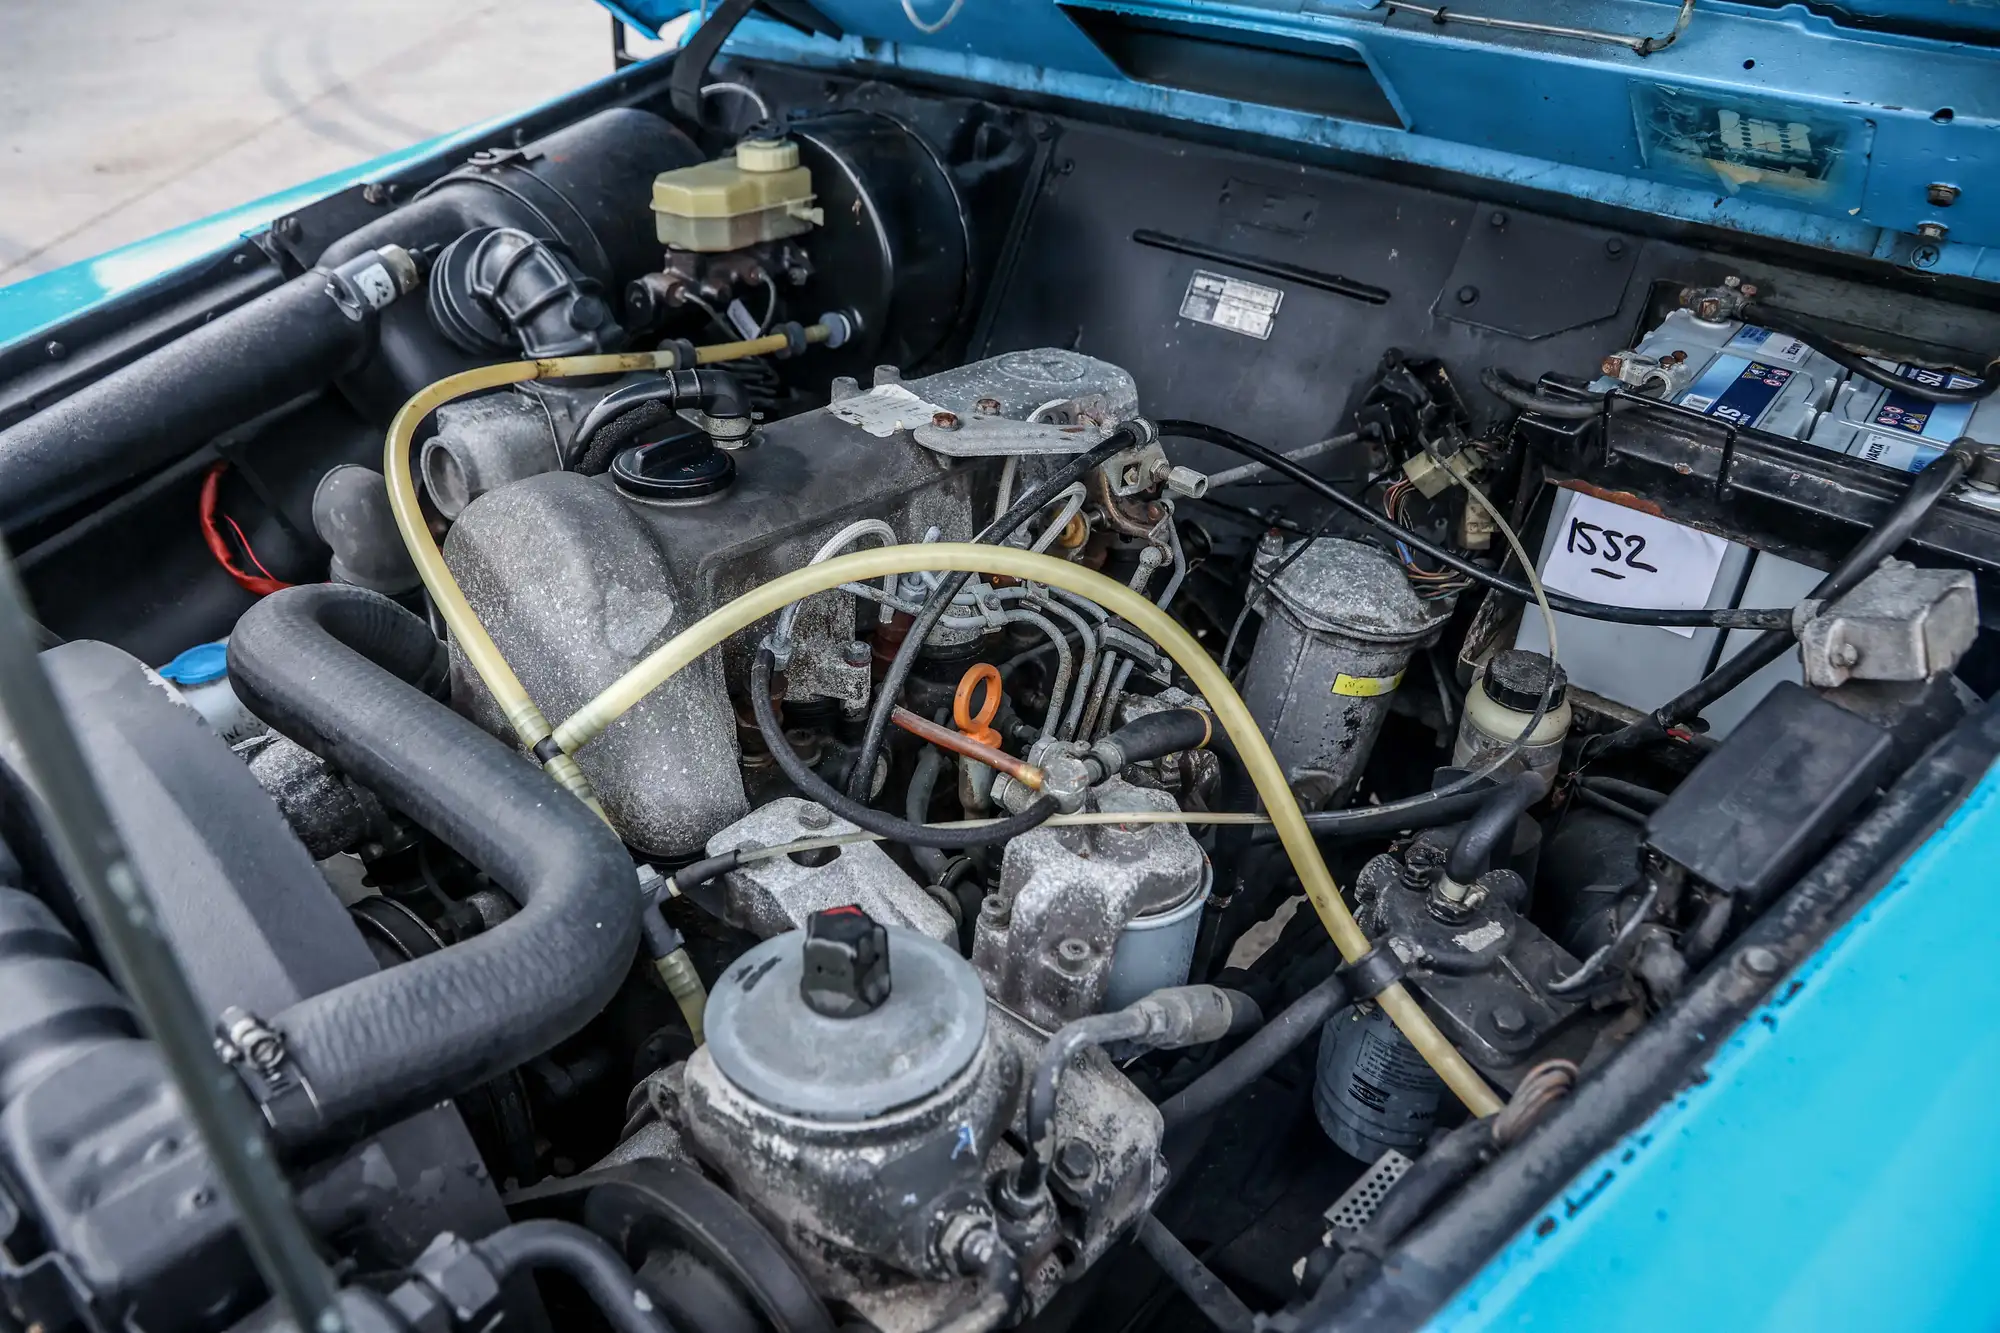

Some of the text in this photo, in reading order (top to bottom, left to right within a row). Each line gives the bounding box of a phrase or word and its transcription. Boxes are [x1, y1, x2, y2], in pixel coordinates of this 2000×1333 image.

[1712, 405, 1742, 422] SL
[1864, 442, 1885, 461] VARTA
[1567, 517, 1658, 573] 1552
